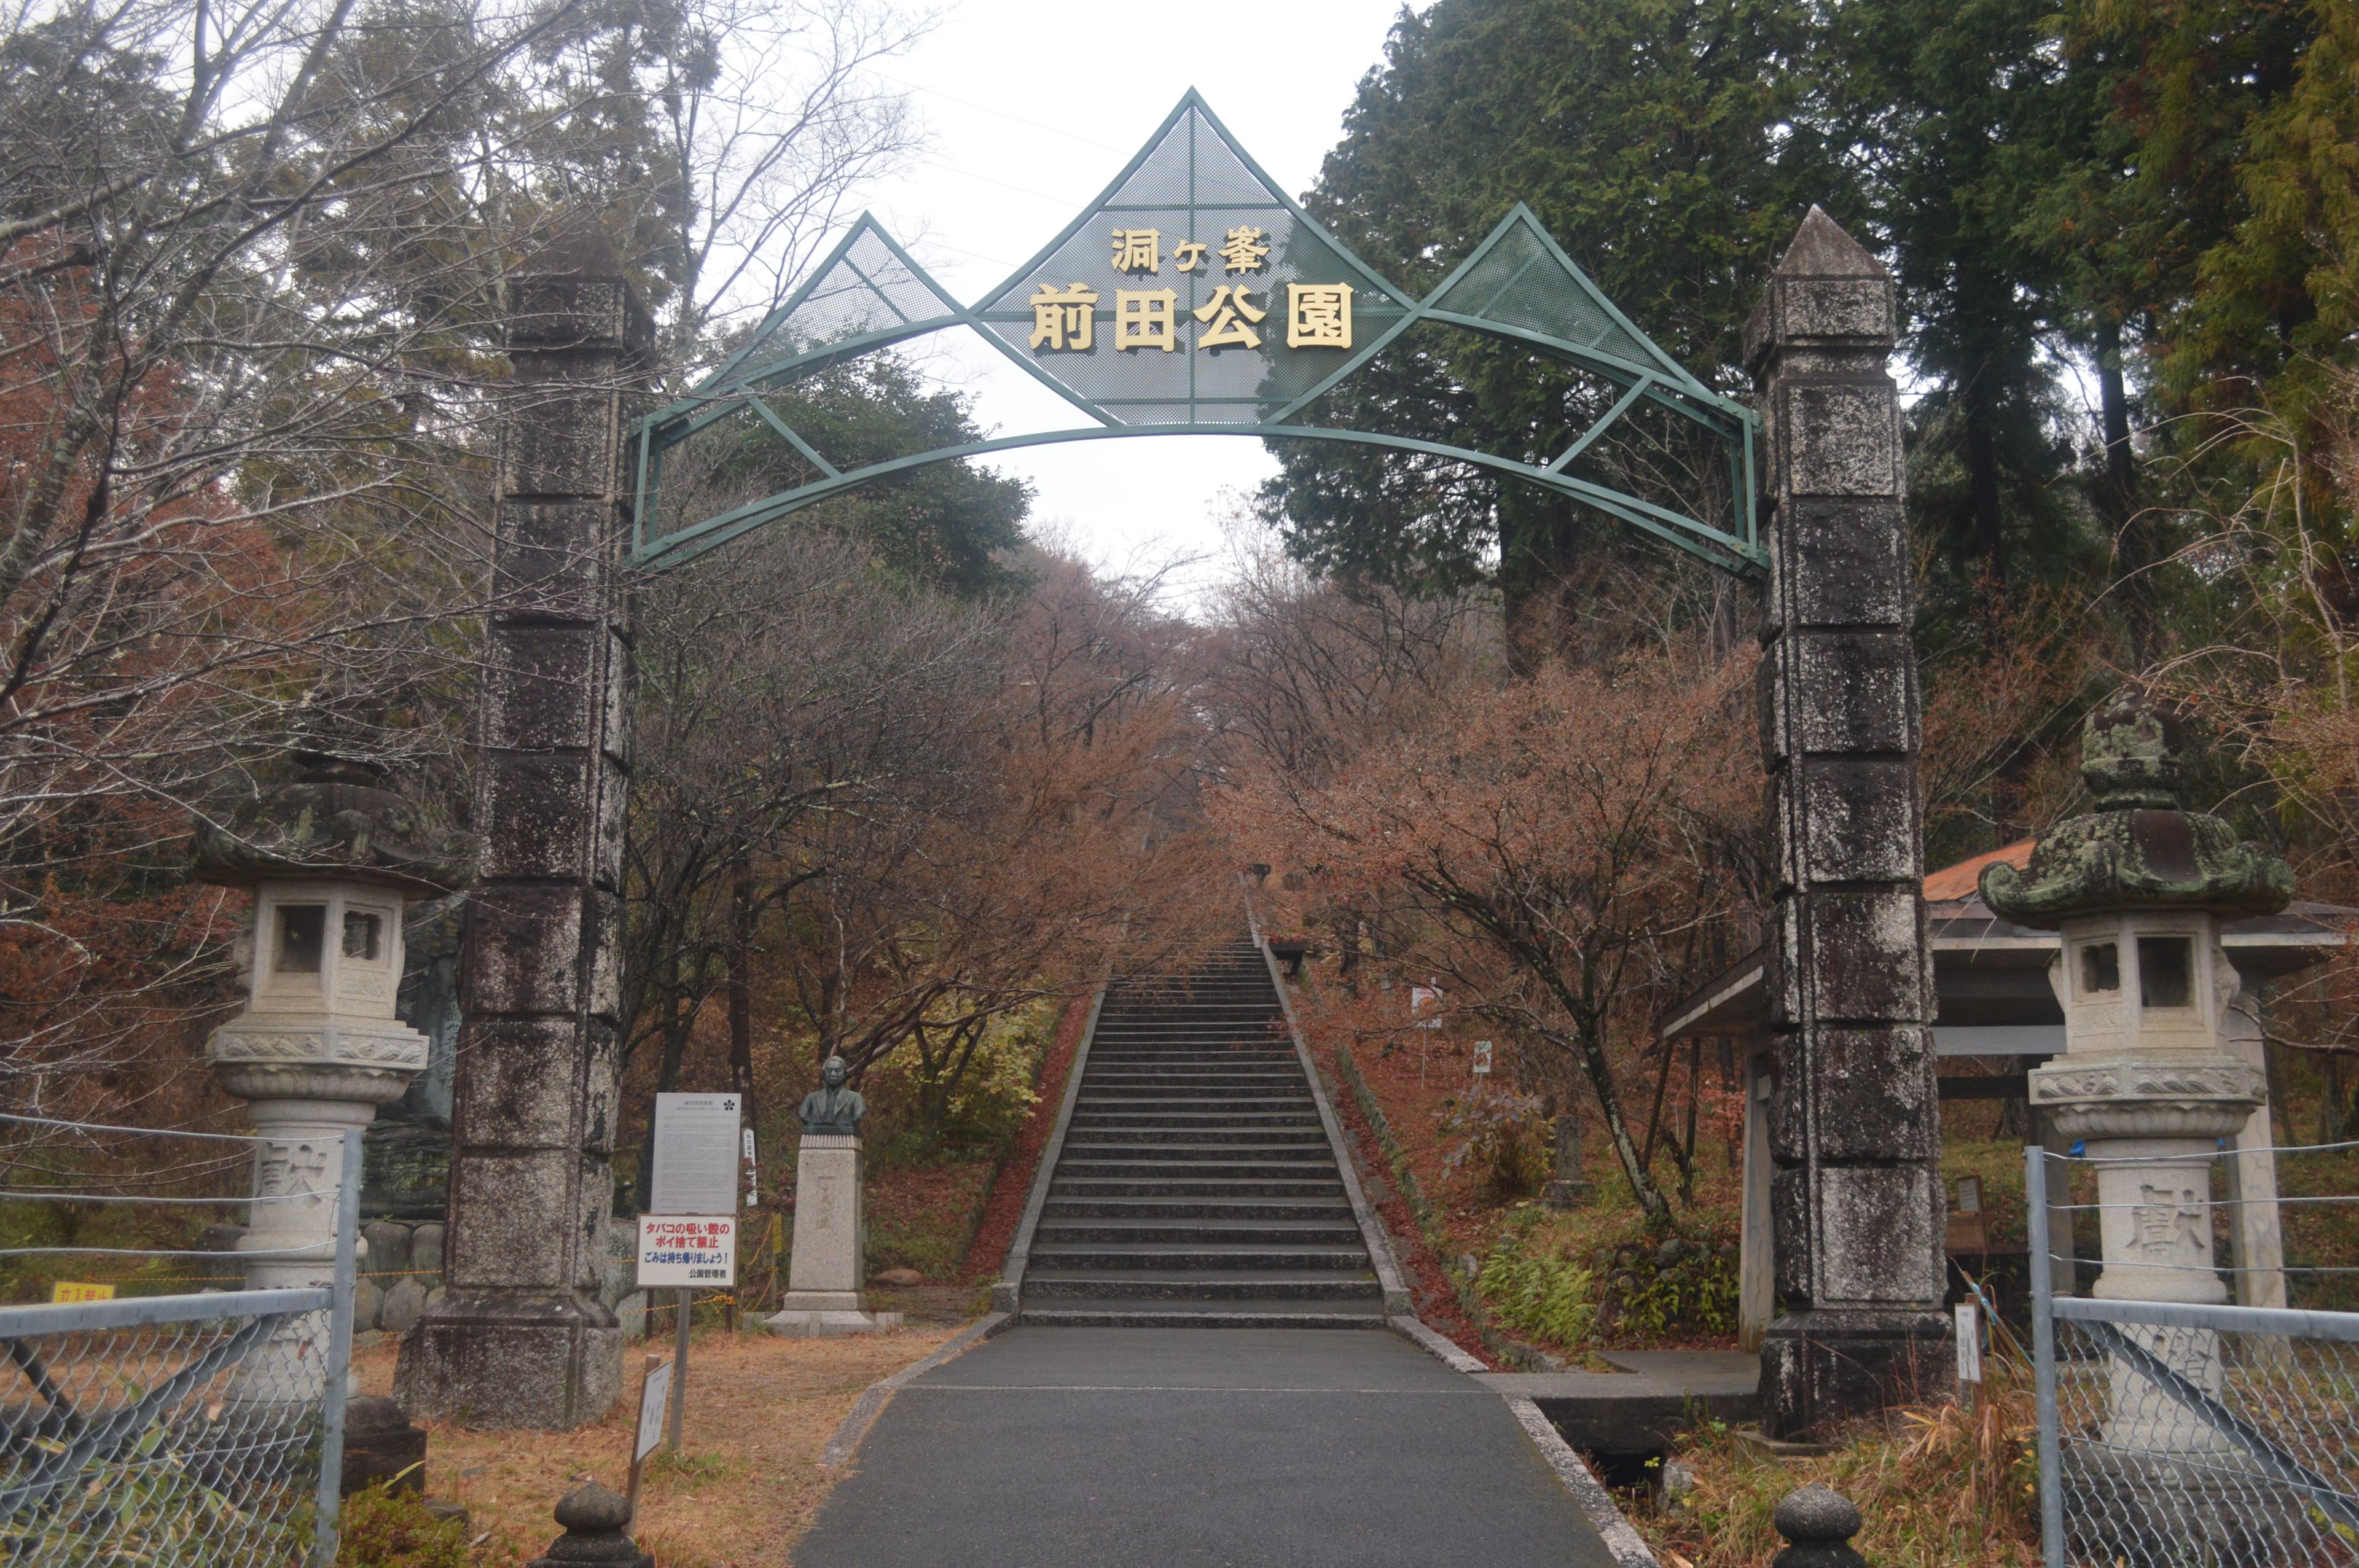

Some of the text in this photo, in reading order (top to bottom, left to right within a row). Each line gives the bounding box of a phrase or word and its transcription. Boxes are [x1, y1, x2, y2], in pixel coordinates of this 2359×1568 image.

[1110, 225, 1270, 275] 洞ヶ峯
[1027, 281, 1355, 353] 前田公園
[646, 1222, 730, 1235] タバコの吸い殻の
[655, 1235, 719, 1248] ポイ捨て禁止
[689, 1269, 727, 1278] 公園管理者
[61, 1287, 108, 1303] 立入禁止
